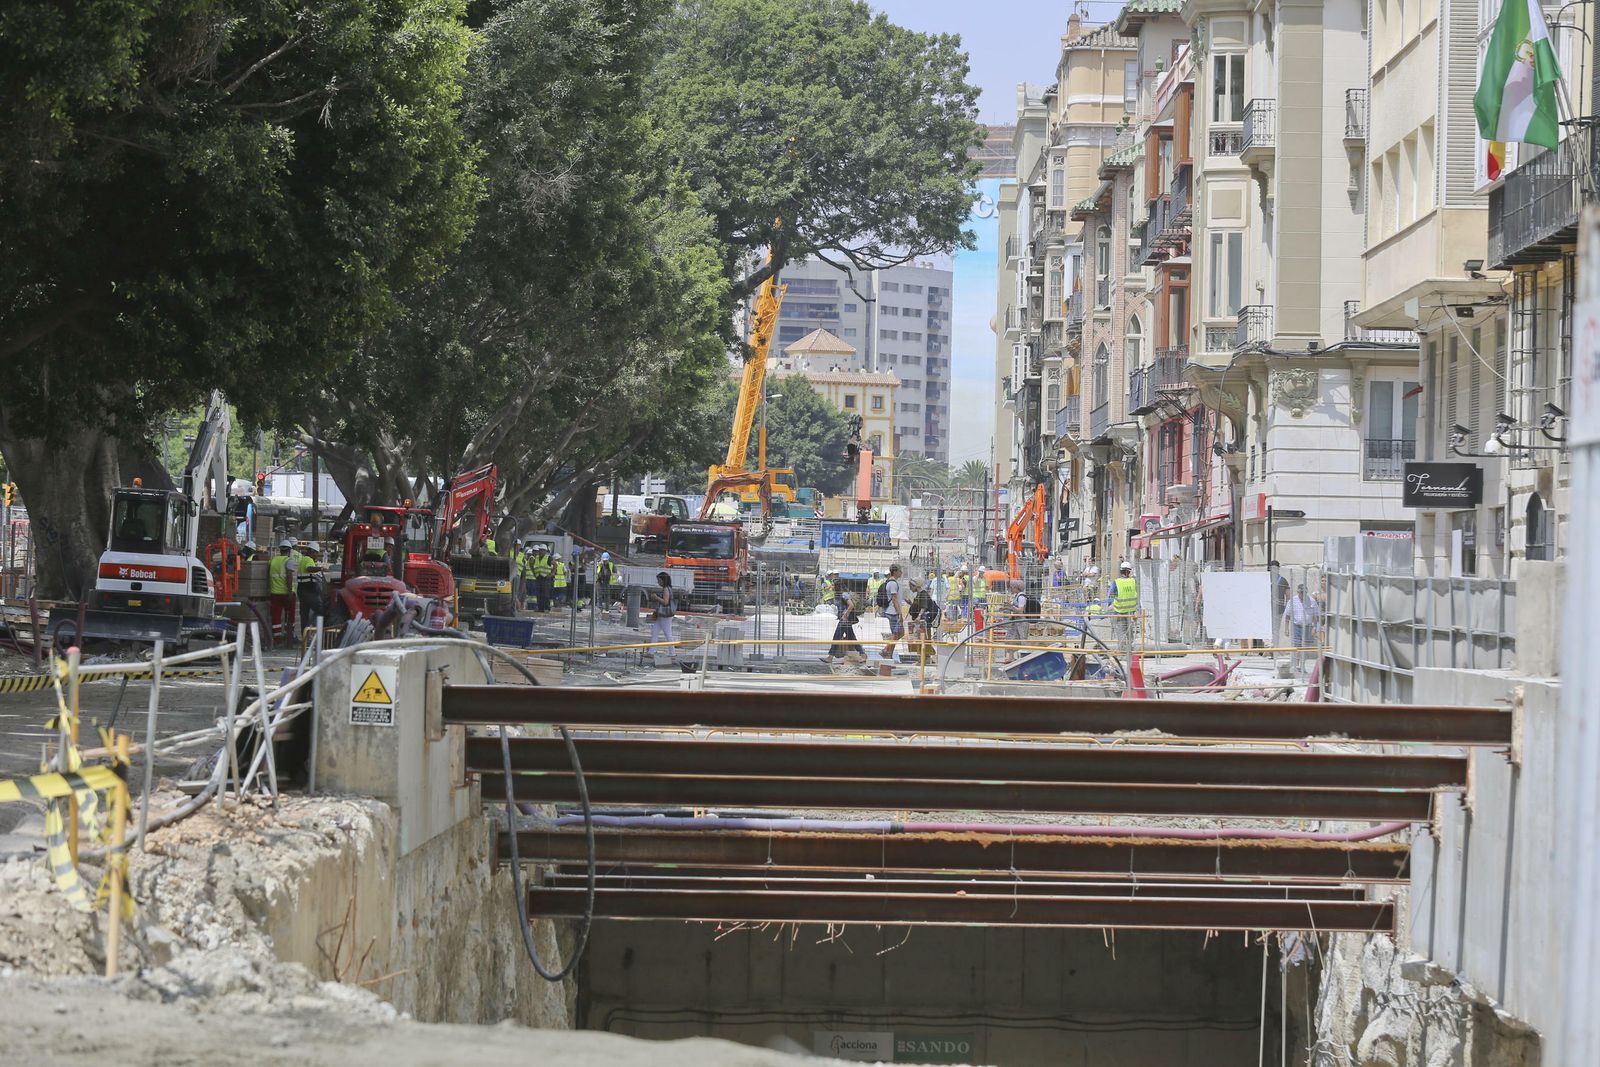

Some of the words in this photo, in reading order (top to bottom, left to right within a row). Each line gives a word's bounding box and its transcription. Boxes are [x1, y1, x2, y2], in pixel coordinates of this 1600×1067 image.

[1407, 473, 1470, 495] Fernando
[130, 569, 157, 579] Bobcat
[840, 1039, 877, 1050] acciona
[905, 1040, 970, 1053] SANDO
